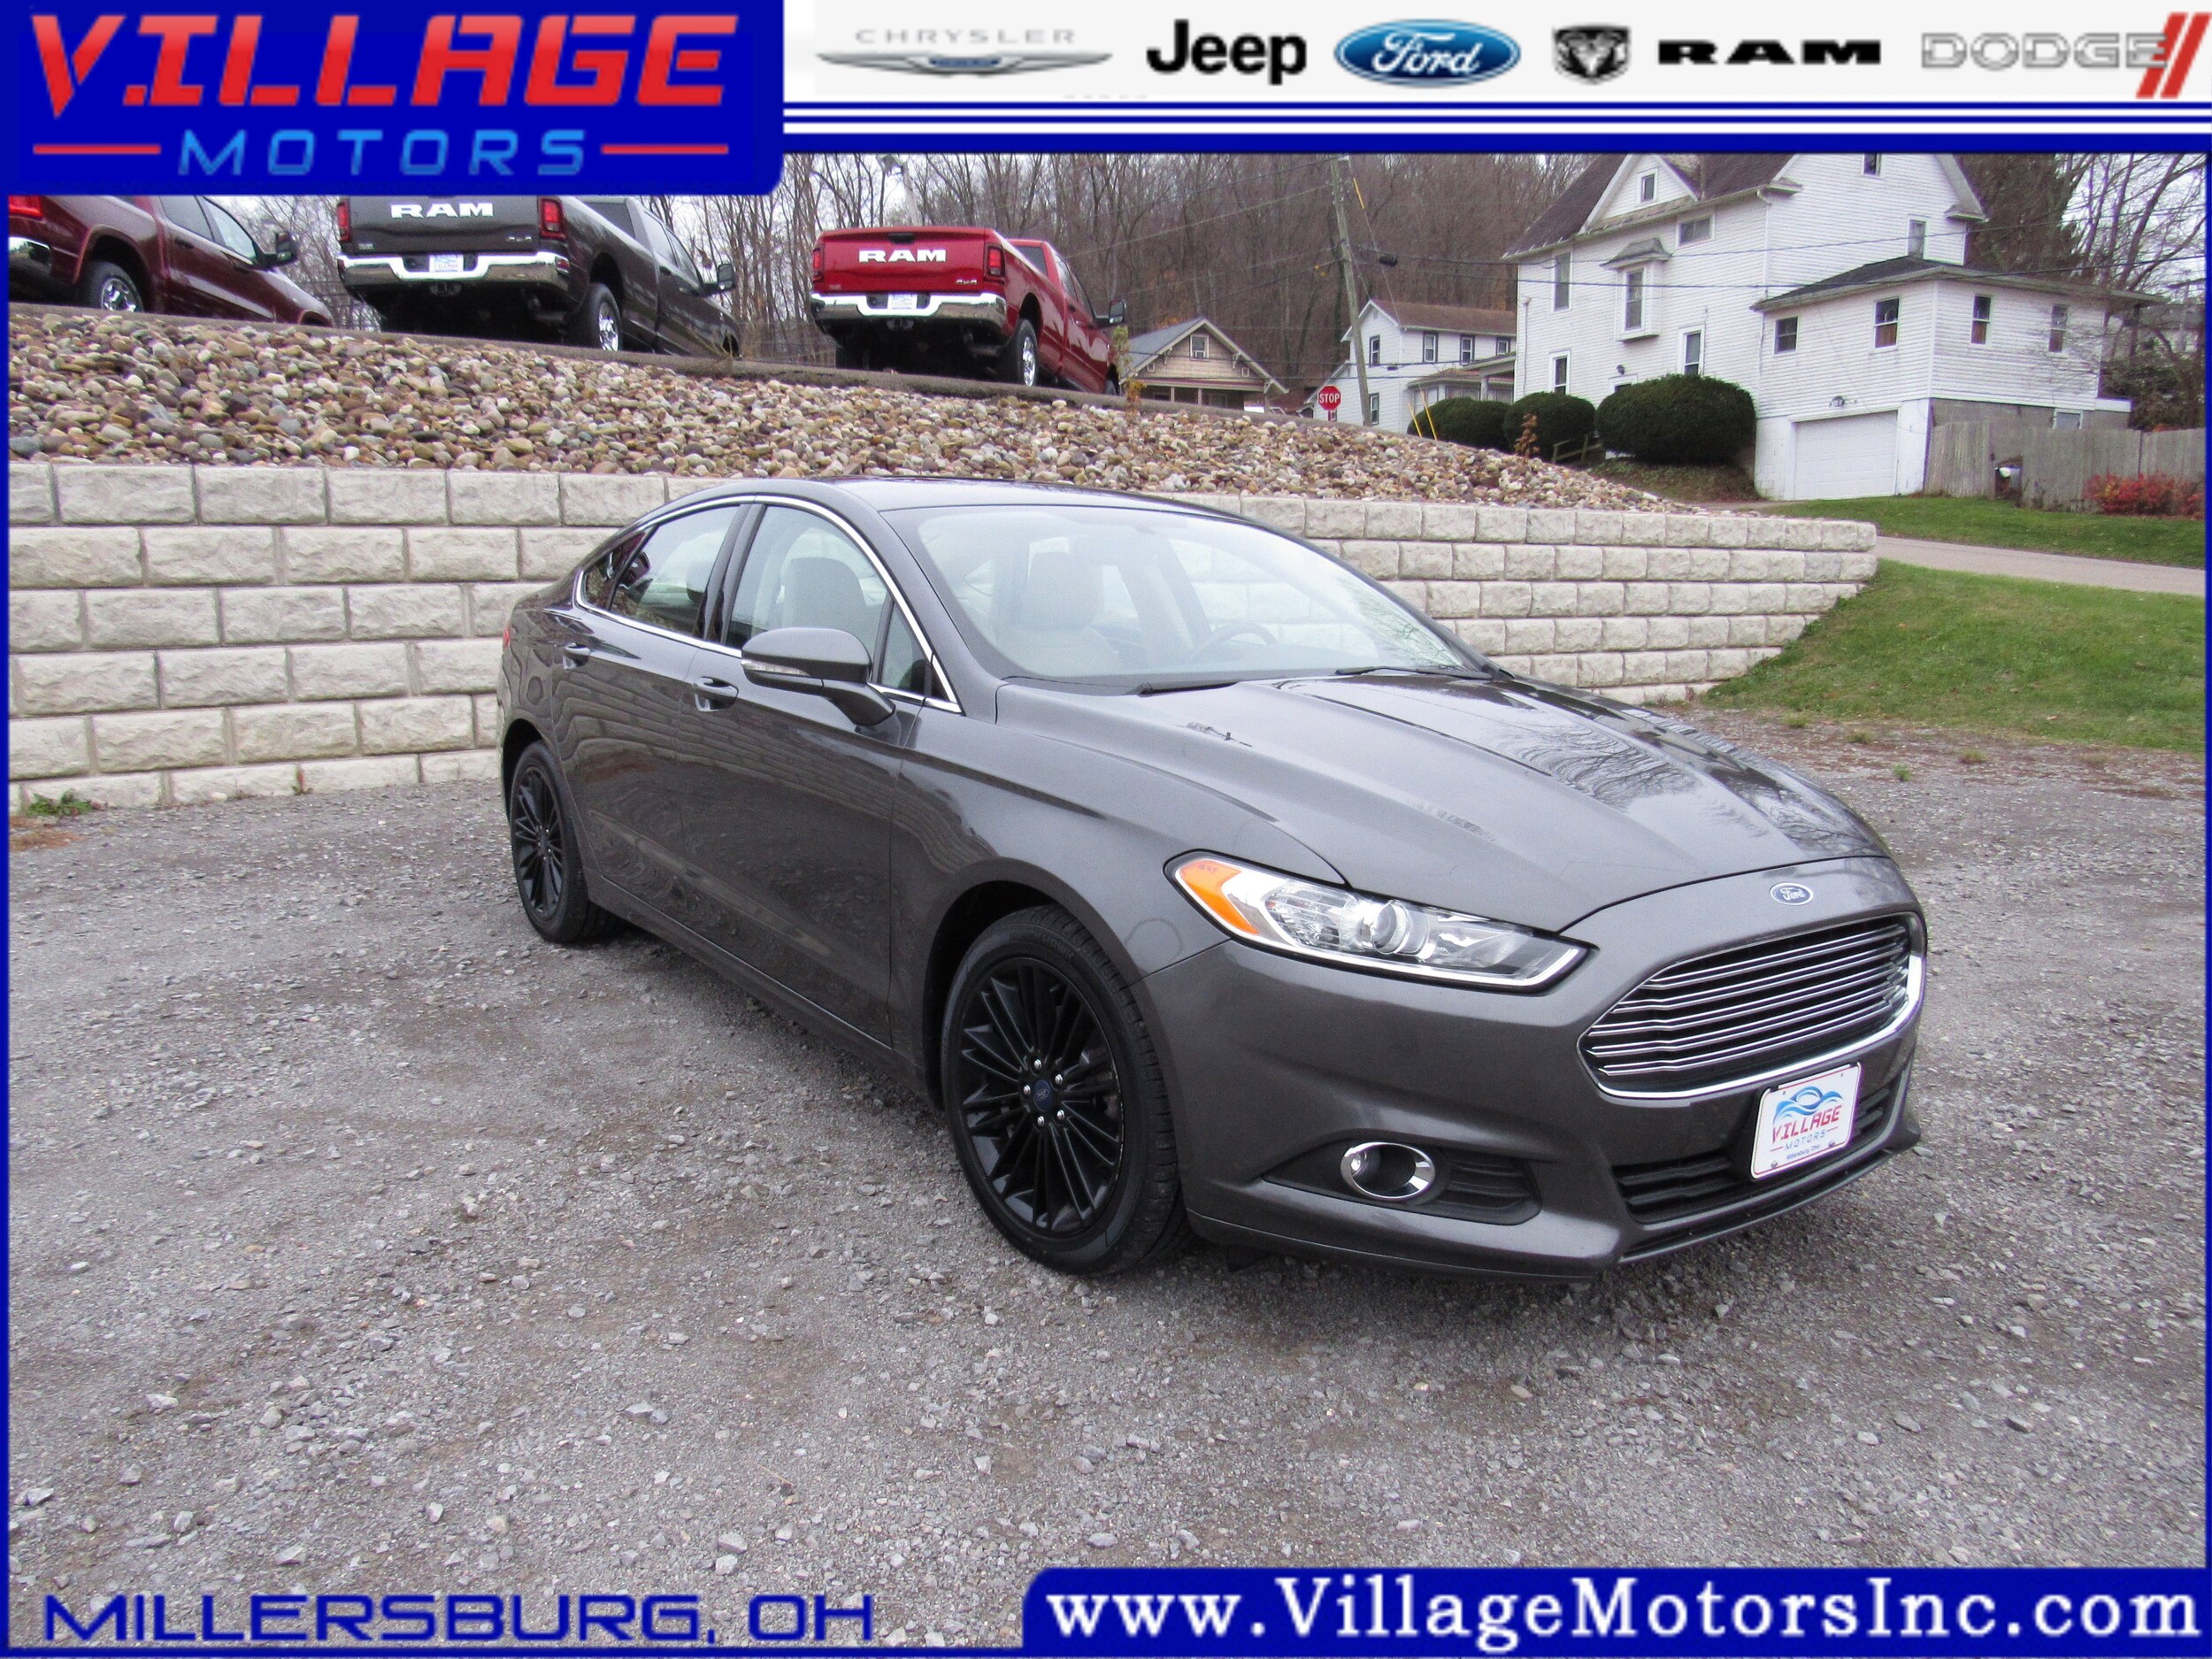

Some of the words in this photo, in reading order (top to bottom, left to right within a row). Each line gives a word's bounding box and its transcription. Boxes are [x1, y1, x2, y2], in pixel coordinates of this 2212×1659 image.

[390, 203, 494, 219] RAM
[858, 249, 947, 263] RAM
[1319, 393, 1340, 403] STOP
[1779, 887, 1805, 901] Ford
[1772, 1105, 1842, 1144] VILLAGE
[1785, 1129, 1826, 1150] MOTORS
